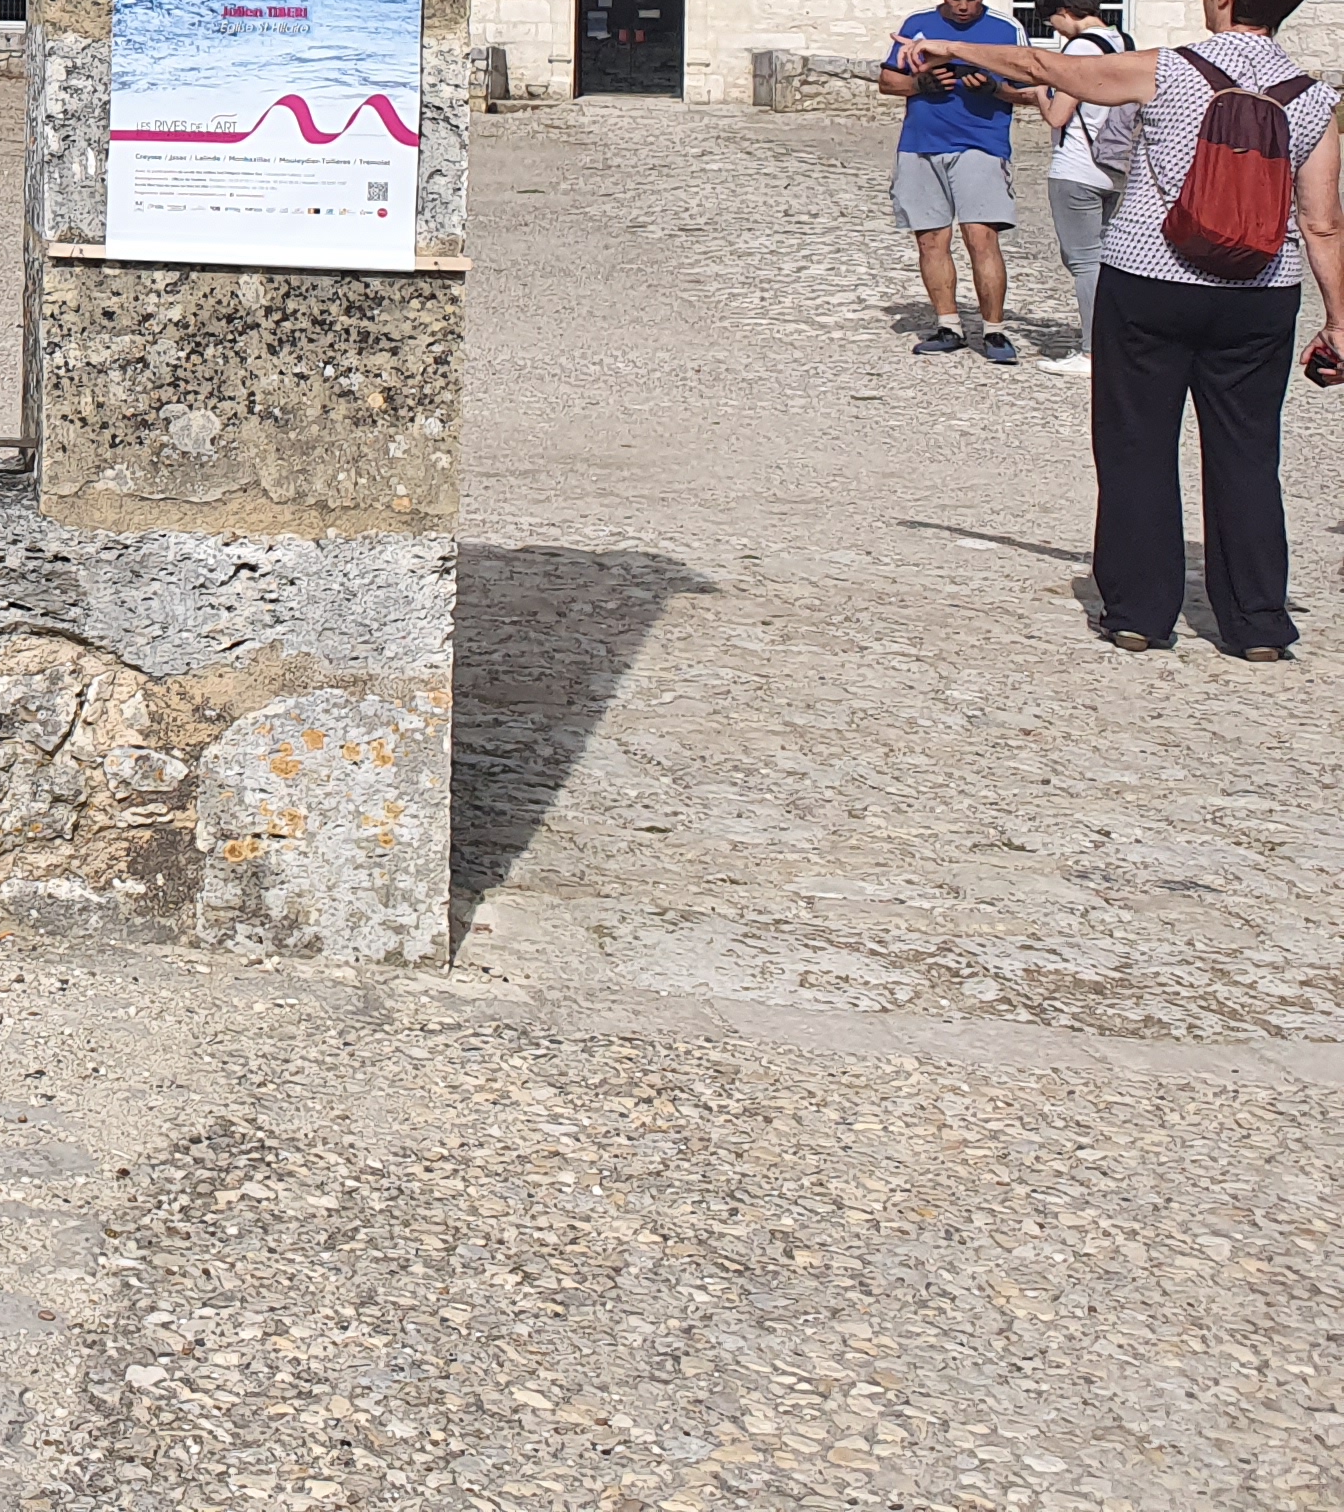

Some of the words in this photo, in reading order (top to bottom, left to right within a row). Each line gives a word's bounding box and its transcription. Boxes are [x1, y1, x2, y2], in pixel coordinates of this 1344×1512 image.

[136, 121, 151, 132] LES
[154, 119, 188, 133] RIVES
[190, 122, 203, 133] DE
